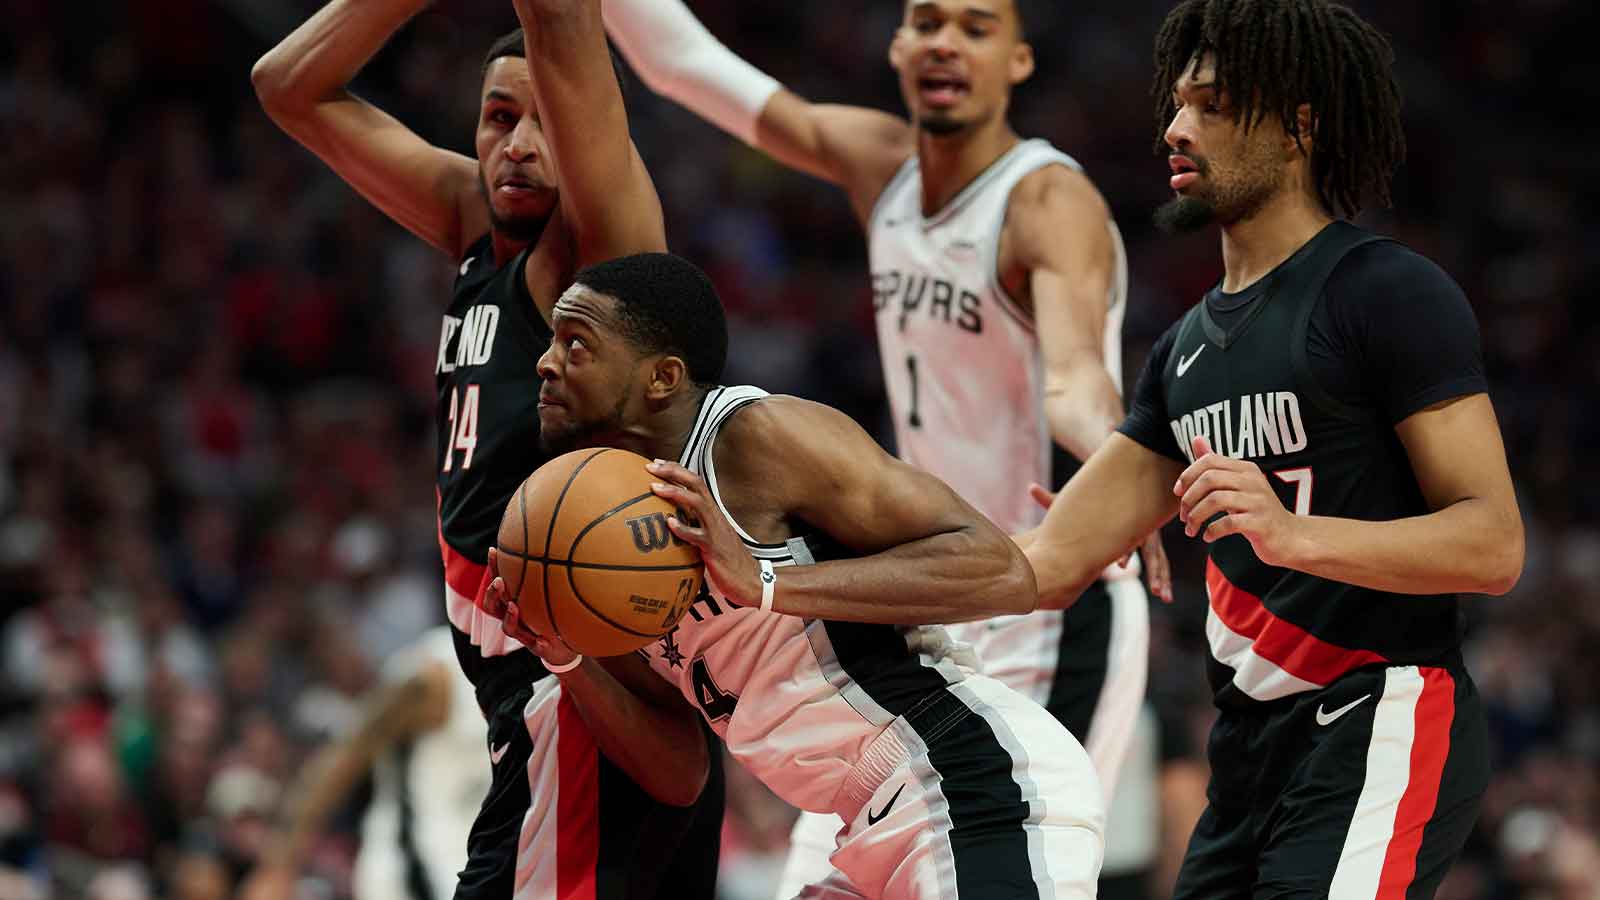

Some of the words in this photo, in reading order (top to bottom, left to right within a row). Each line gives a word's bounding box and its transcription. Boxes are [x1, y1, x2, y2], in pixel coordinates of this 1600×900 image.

[443, 384, 480, 472] 14
[905, 354, 922, 429] 1
[1169, 391, 1308, 465] PORTLAND
[1264, 465, 1313, 517] 7
[690, 655, 741, 723] 4
